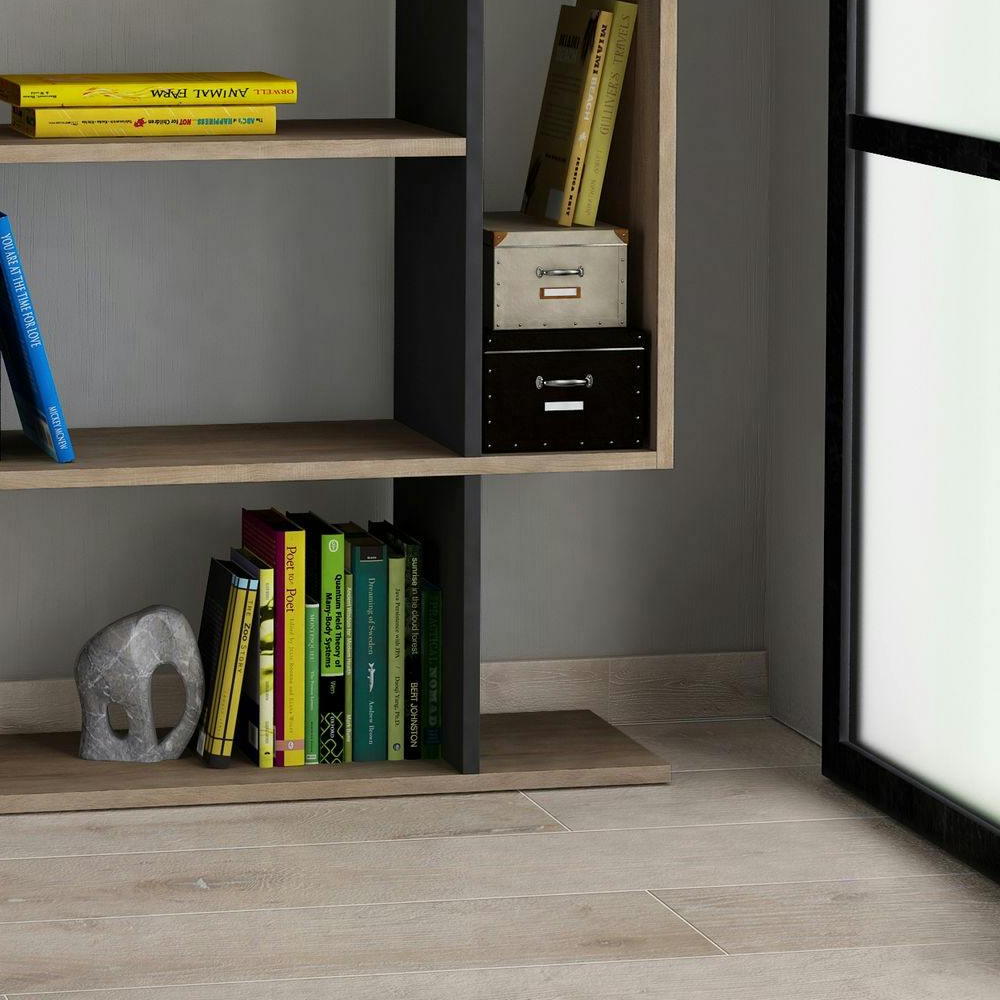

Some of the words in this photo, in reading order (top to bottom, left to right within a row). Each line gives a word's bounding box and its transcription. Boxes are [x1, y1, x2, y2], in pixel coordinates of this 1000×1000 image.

[592, 24, 607, 74] MIAMI
[599, 72, 619, 135] GULLIVER'S
[613, 14, 631, 64] TRAVELS
[150, 89, 187, 98] FARM
[192, 87, 249, 98] ANIMAL
[583, 76, 598, 121] BEACH
[570, 157, 581, 192] JESSICA
[1, 233, 14, 251] YOU
[6, 251, 19, 265] ARE
[13, 275, 26, 293] THE
[18, 293, 31, 312] TIME
[23, 312, 36, 328] FOR
[27, 327, 42, 348] LOVE
[285, 546, 297, 570] Poet
[411, 557, 419, 586] sunrise
[285, 588, 296, 612] Poet
[334, 574, 342, 609] Quantum
[367, 577, 375, 615] Dreaming
[412, 587, 419, 595] in
[246, 600, 254, 617] THE
[324, 592, 332, 636] Many-Body
[368, 616, 375, 624] of
[411, 610, 419, 631] cloud
[324, 638, 332, 668] Systems
[333, 633, 342, 659] Theory
[411, 632, 419, 655] forest
[237, 645, 247, 674] STORY
[335, 660, 342, 668] of
[410, 682, 418, 701] BERT
[429, 666, 438, 727] NOMAD
[410, 703, 418, 747] JOHNSTON
